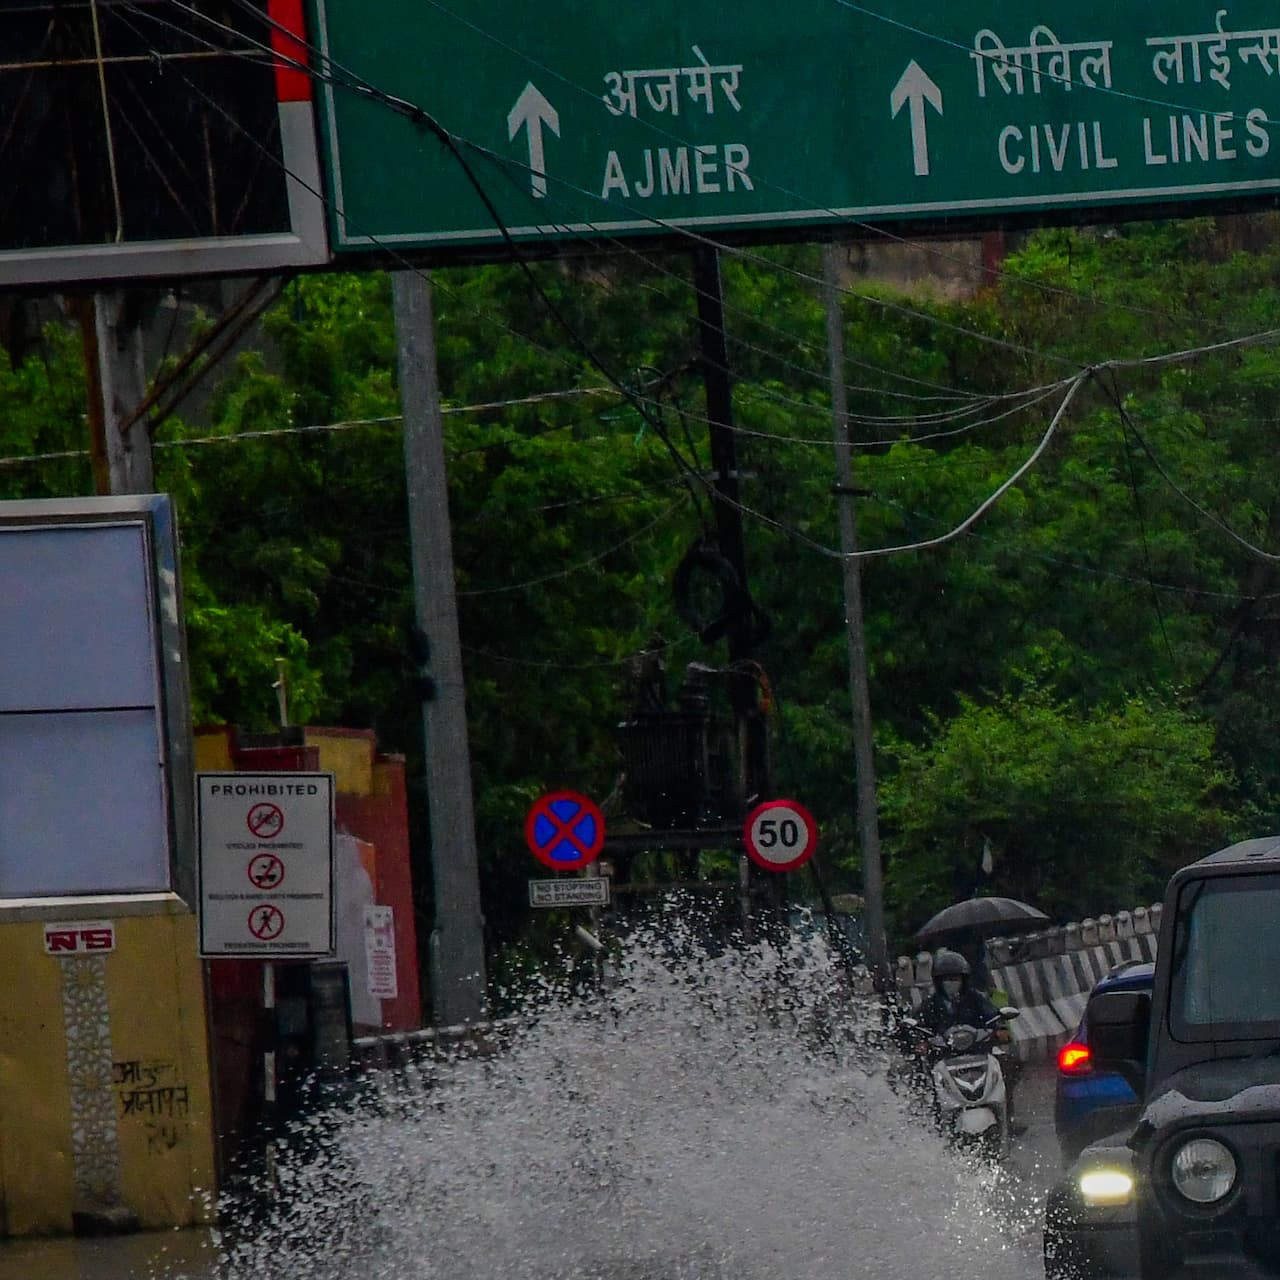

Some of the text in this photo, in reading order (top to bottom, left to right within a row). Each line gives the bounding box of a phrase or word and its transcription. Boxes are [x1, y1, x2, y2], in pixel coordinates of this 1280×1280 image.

[602, 45, 743, 118] अजमेर
[970, 24, 1113, 97] सिविल
[602, 143, 754, 199] AJMER
[998, 108, 1270, 174] CIVIL LINES
[210, 784, 318, 796] PROHIBITED
[759, 819, 798, 848] 50
